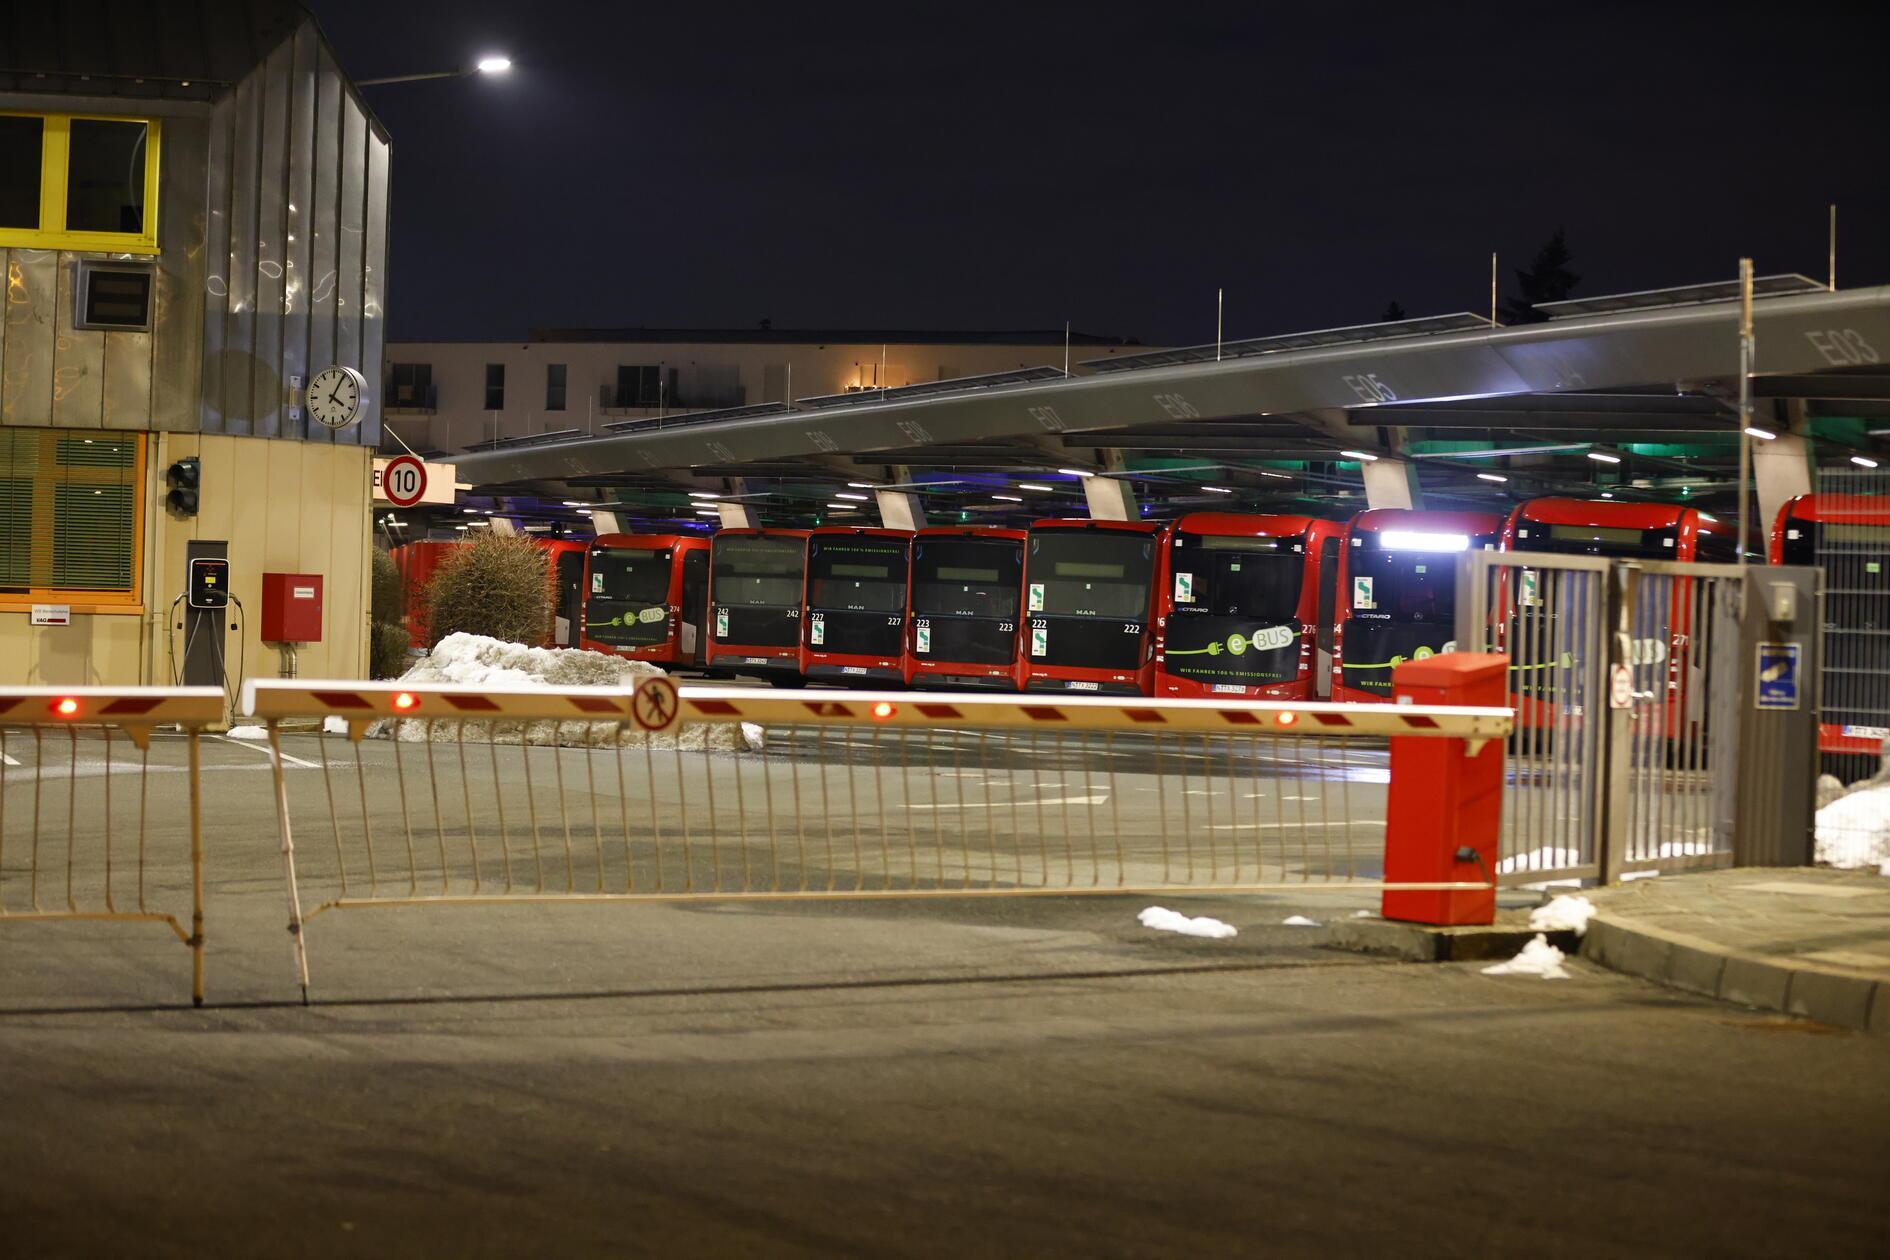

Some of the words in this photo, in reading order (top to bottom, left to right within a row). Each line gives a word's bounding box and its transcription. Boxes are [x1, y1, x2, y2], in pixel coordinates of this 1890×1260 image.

[1804, 329, 1879, 365] E03
[1342, 373, 1397, 402] E05
[1152, 393, 1199, 419] E06
[1027, 406, 1065, 431] E07
[394, 469, 415, 493] 10
[642, 609, 662, 622] BUS
[786, 610, 799, 618] 242
[811, 613, 824, 621] 227
[887, 617, 901, 626] 227
[916, 619, 930, 628] 223
[1032, 619, 1047, 629] 222
[998, 623, 1013, 632] 223
[1123, 624, 1140, 634] 222
[1301, 624, 1316, 634] 276
[1231, 637, 1242, 651] e
[1256, 628, 1289, 648] BUS
